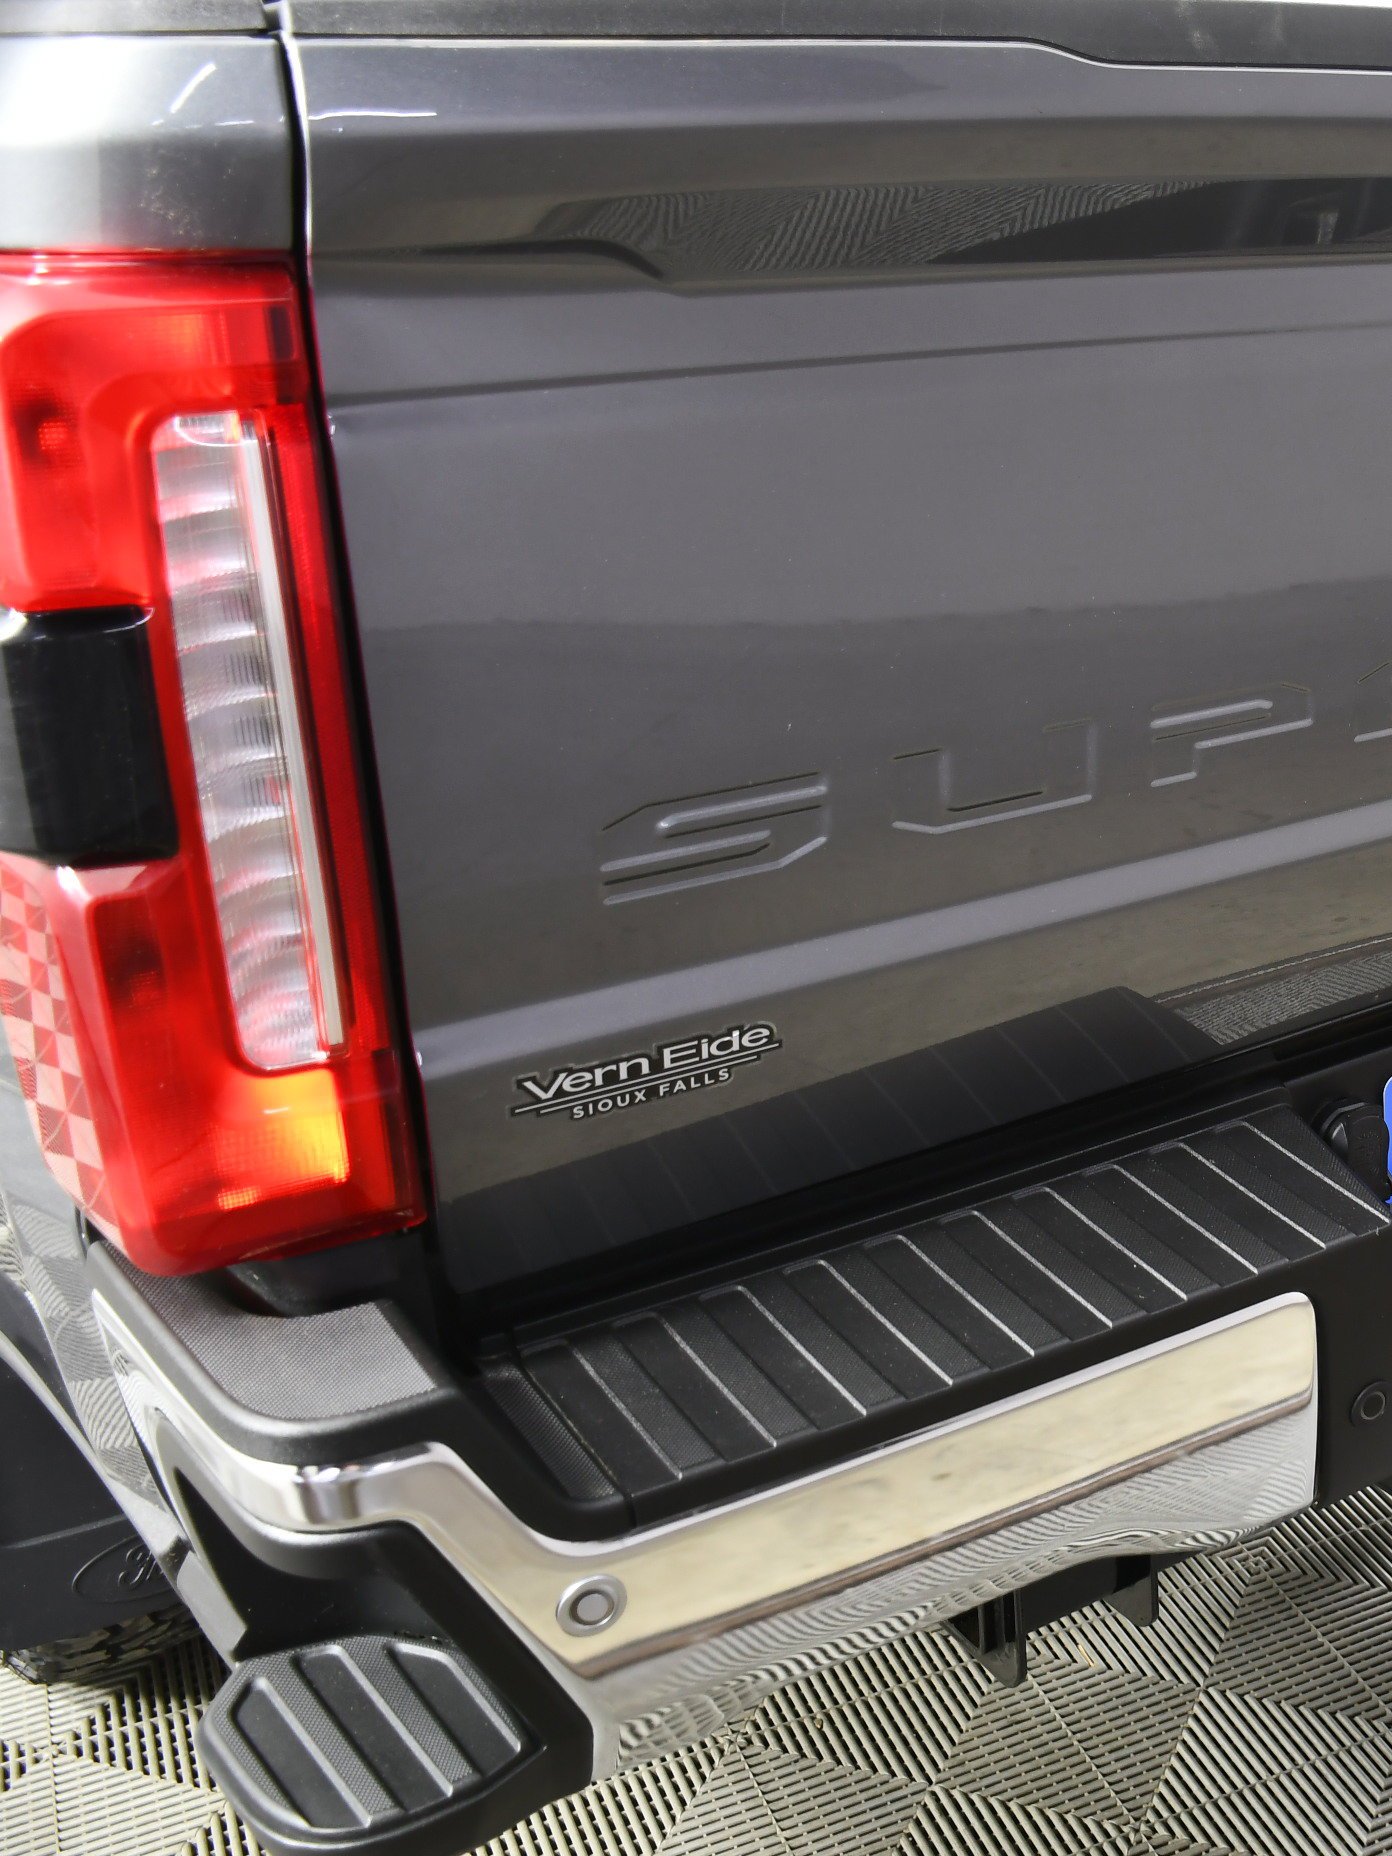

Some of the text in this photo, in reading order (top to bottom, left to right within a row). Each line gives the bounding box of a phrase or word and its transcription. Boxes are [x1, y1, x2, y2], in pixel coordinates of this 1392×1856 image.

[522, 1026, 771, 1101] Vern Eide
[572, 1068, 730, 1119] SIOUX FALLS
